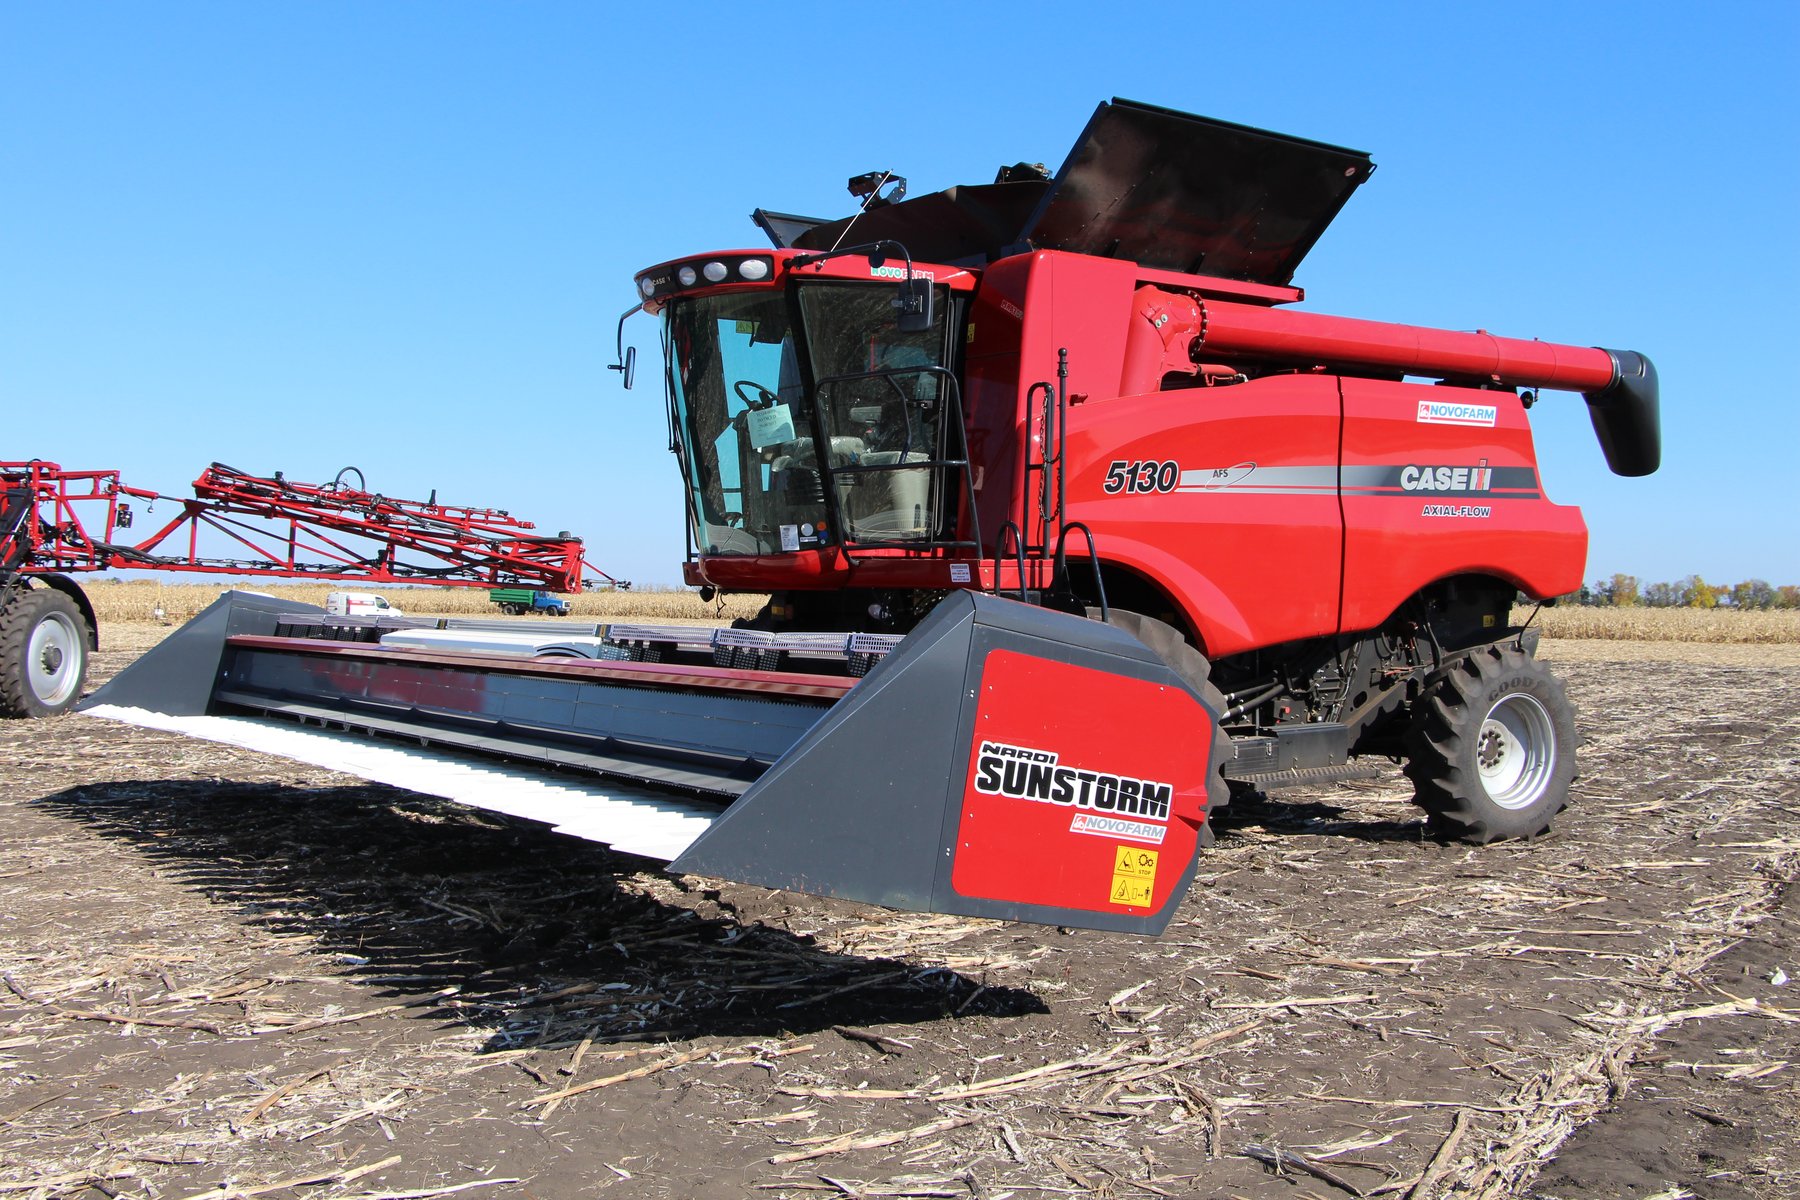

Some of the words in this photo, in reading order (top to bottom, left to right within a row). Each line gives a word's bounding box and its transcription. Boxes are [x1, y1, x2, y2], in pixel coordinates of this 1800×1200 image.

[1430, 405, 1495, 420] NOVOFARM
[1103, 461, 1178, 493] 5130
[1212, 469, 1229, 478] AFS
[1400, 466, 1469, 491] CASE
[1423, 505, 1491, 517] AXIAL-FLOW
[982, 744, 1056, 764] NARDI
[977, 756, 1171, 818] SUNSTORM
[1085, 816, 1165, 838] NOVOFARM
